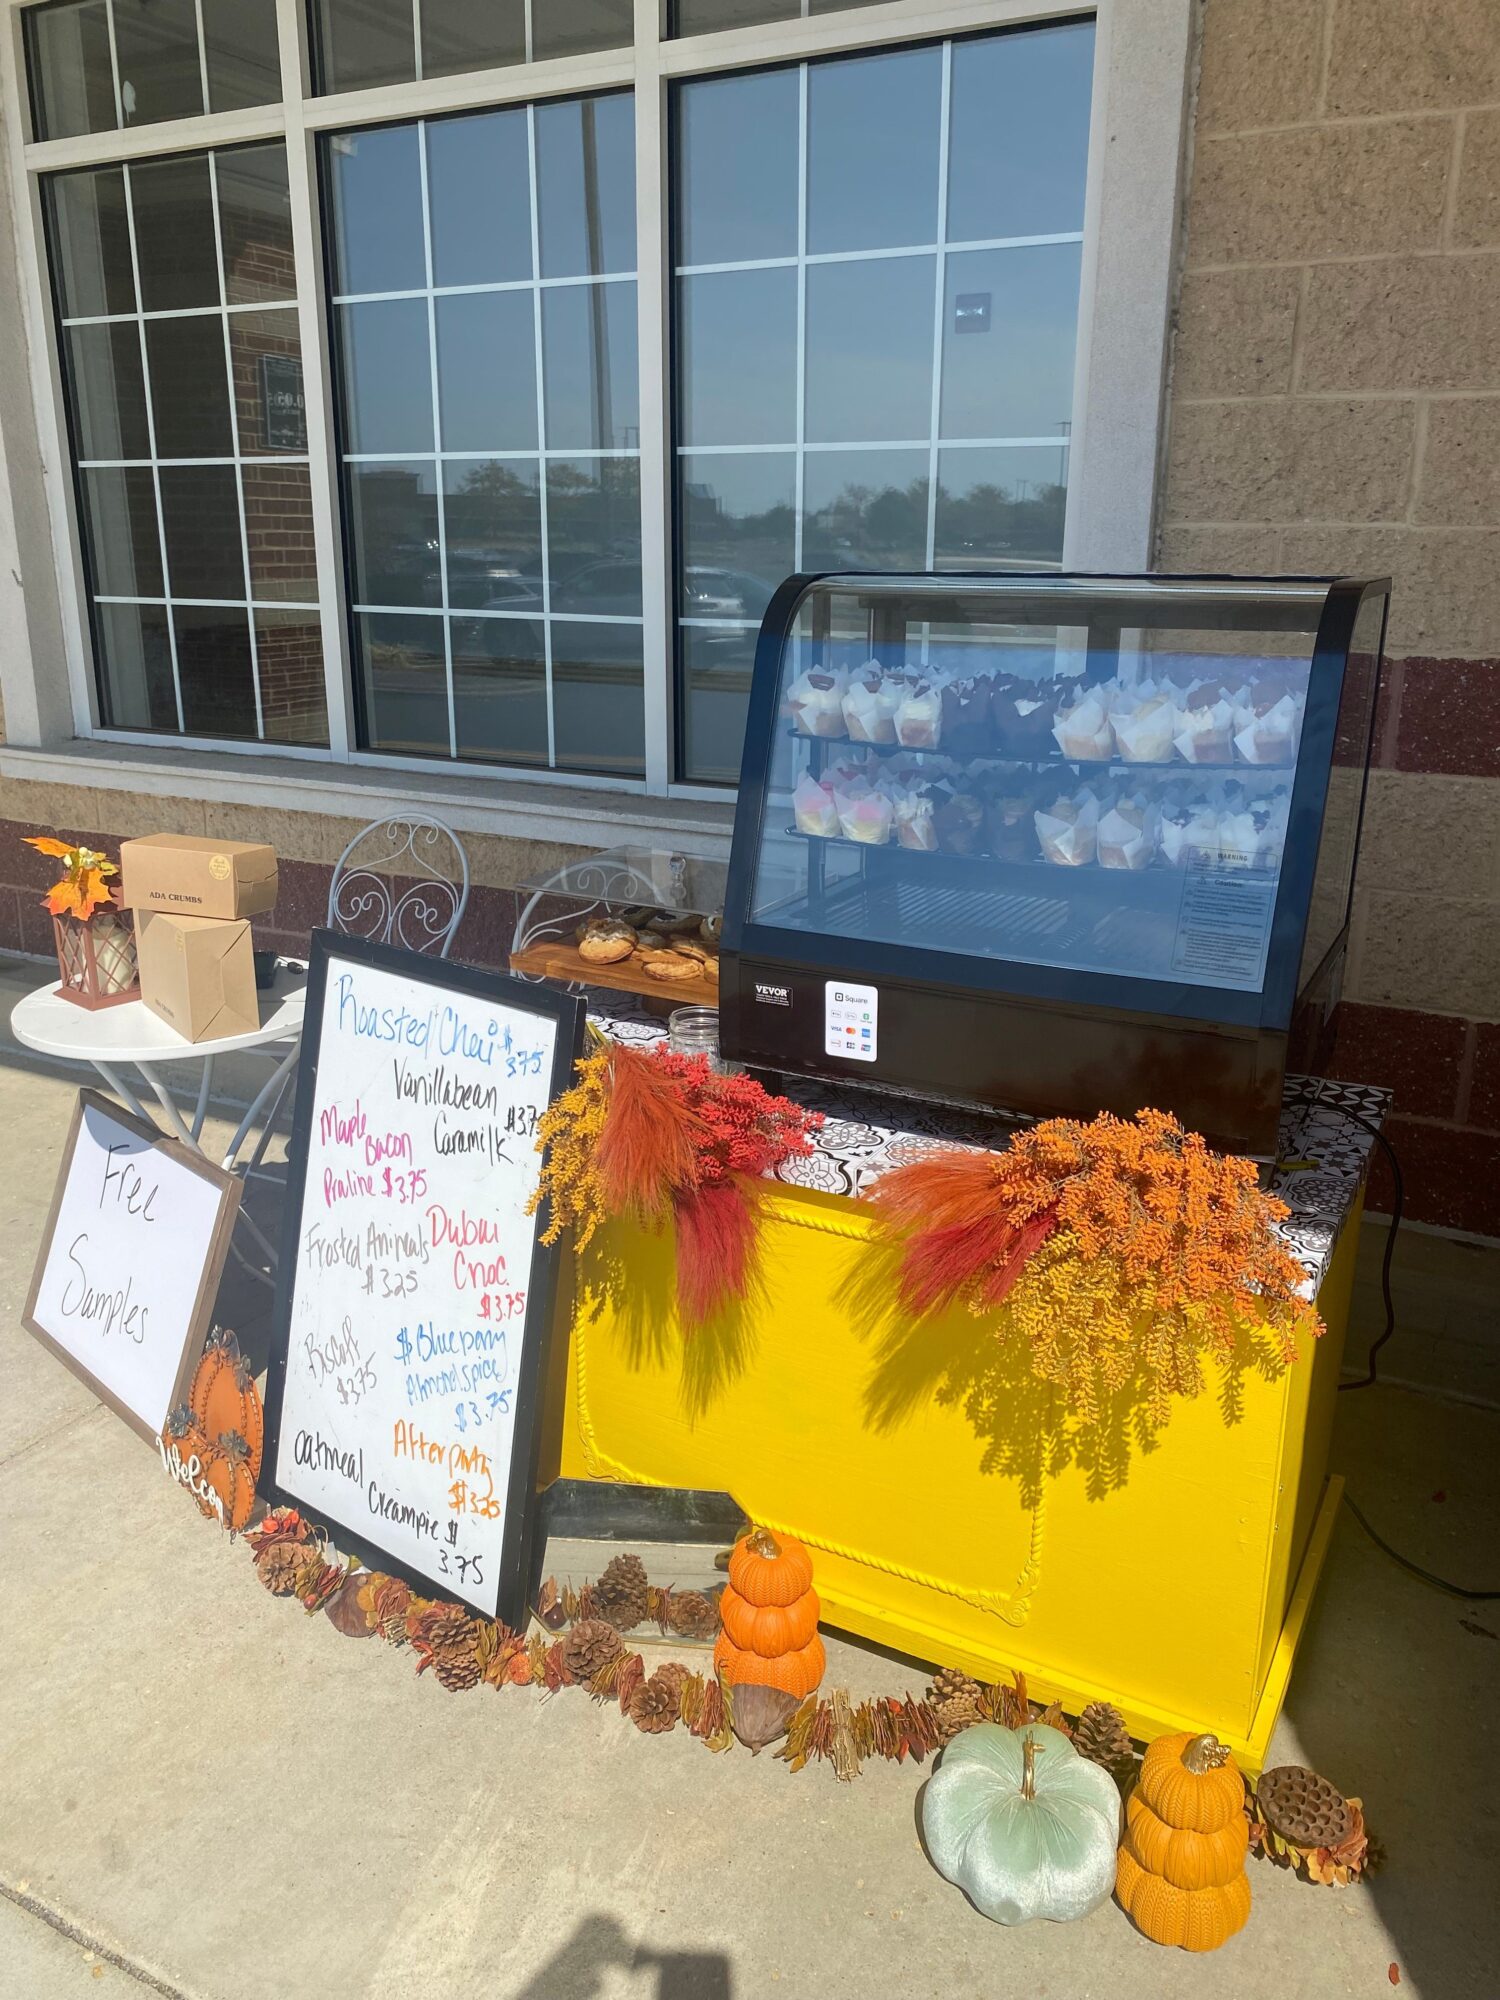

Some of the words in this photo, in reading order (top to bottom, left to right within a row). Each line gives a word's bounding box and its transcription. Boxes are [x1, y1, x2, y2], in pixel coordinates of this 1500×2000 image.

[1217, 852, 1248, 861] WARNING
[149, 891, 166, 900] ADA
[168, 893, 203, 904] CRUMBS
[755, 984, 788, 998] VEVOR
[338, 974, 434, 1060] Roasted
[320, 1099, 367, 1147] Maple
[365, 1132, 413, 1167] Bacon
[99, 1144, 160, 1222] Free
[323, 1167, 377, 1209] Praline
[304, 1222, 362, 1271] Frosted
[426, 1204, 500, 1248] Dubai
[60, 1232, 149, 1344] Samples
